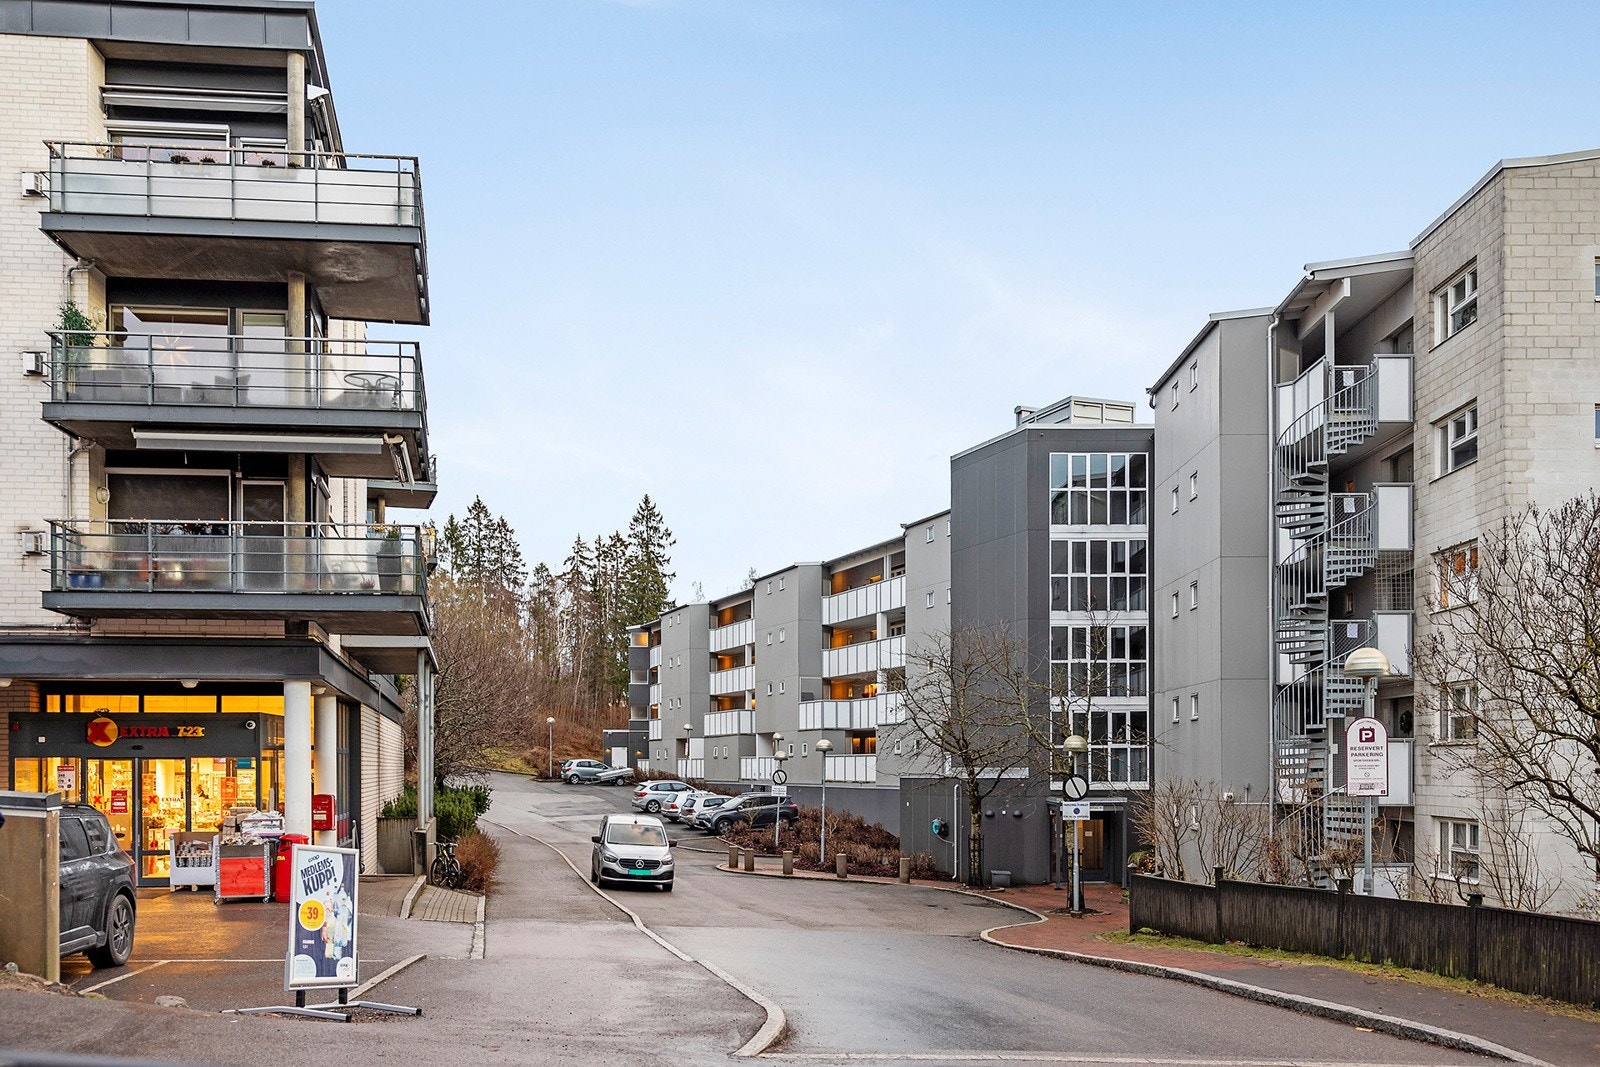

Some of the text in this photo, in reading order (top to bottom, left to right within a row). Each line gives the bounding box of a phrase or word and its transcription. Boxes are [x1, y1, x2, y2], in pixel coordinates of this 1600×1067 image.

[120, 726, 170, 737] EXTRA
[300, 857, 333, 880] MEDLEMS-
[302, 866, 338, 896] KUPP!
[306, 906, 319, 920] 39
